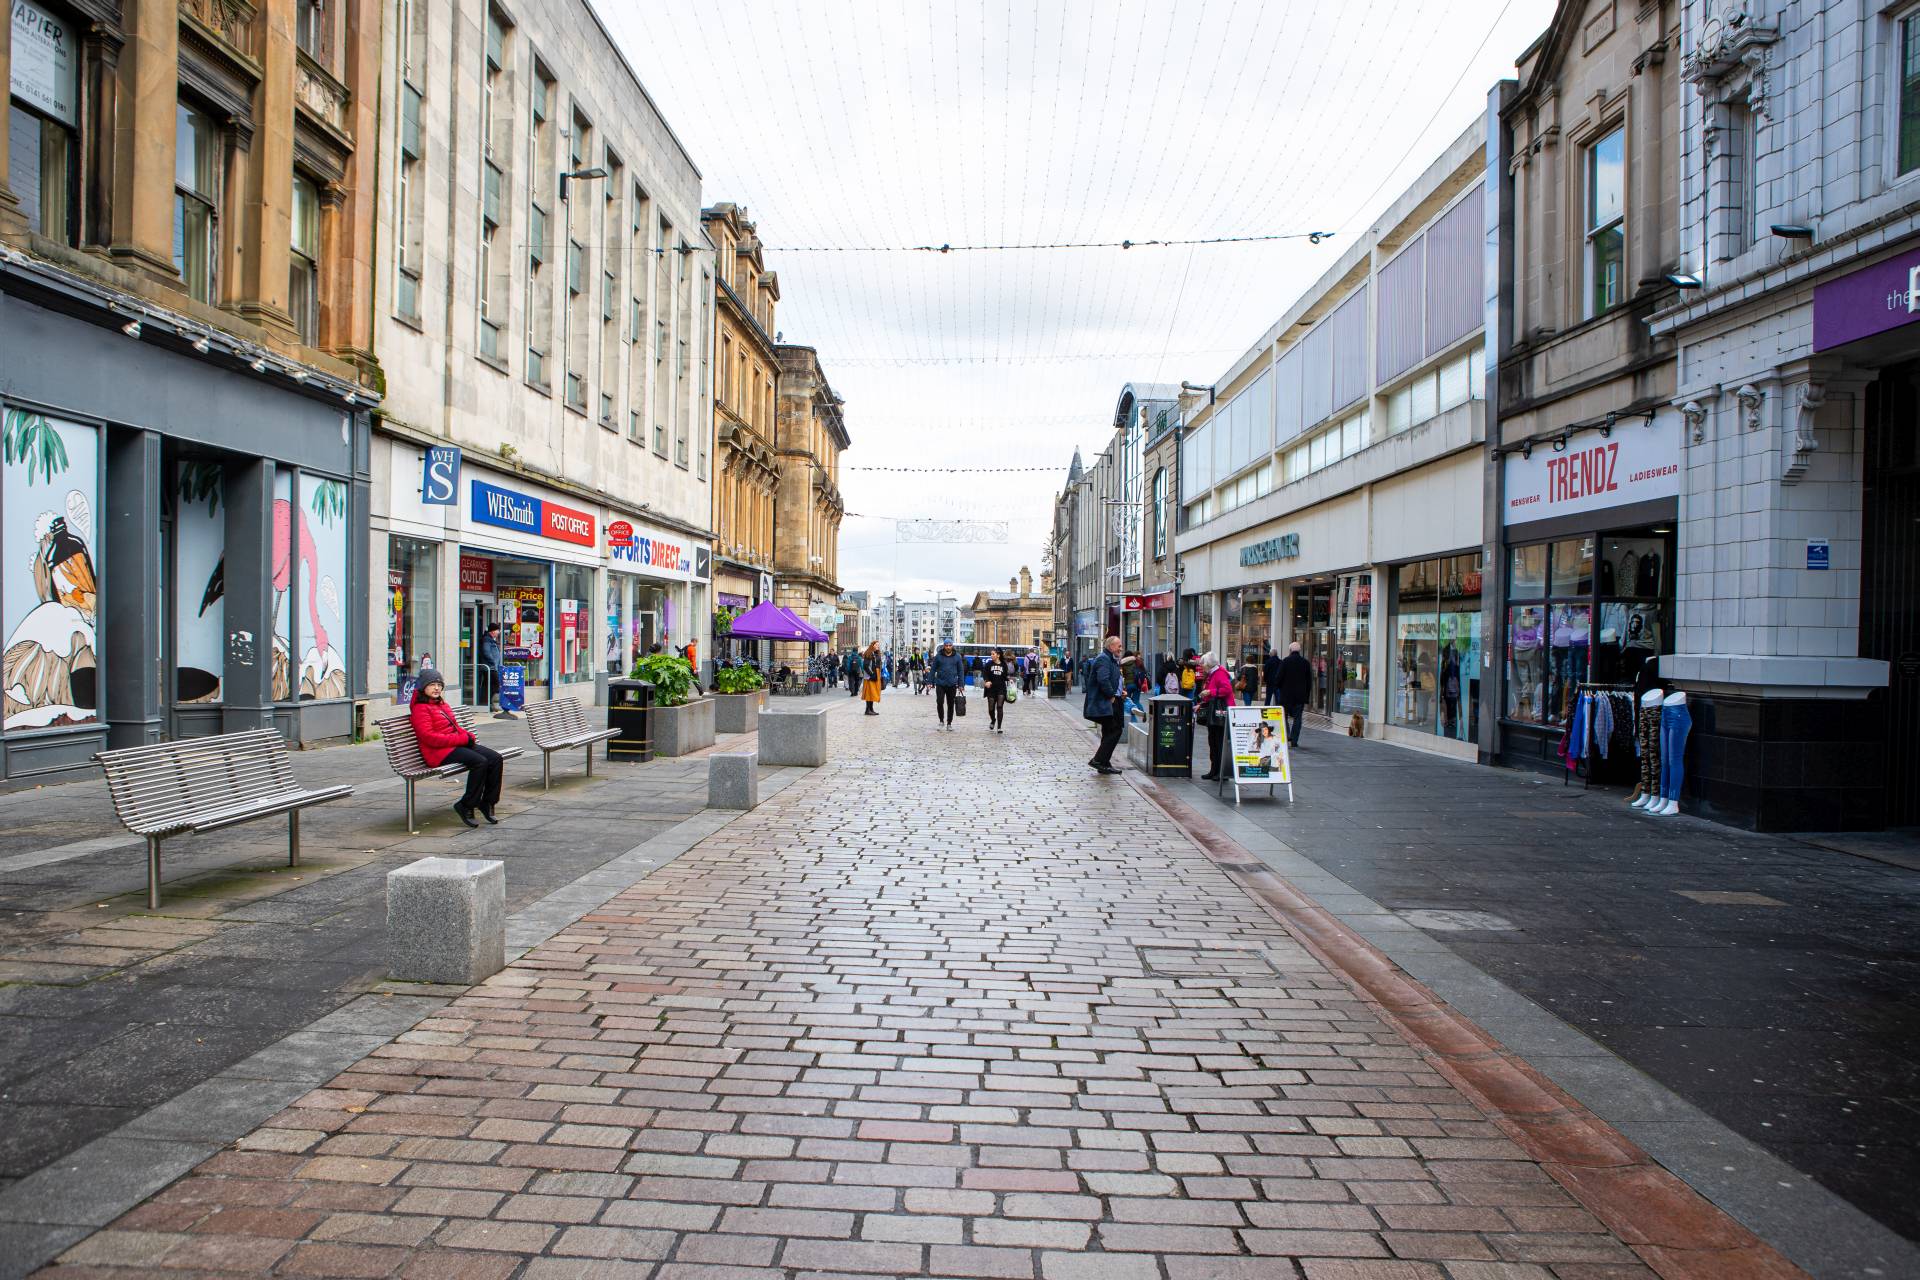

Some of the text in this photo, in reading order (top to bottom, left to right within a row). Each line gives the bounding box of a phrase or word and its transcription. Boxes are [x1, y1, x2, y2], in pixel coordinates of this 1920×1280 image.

[430, 450, 454, 462] WH
[1546, 442, 1619, 504] TRENDZ
[1629, 465, 1678, 482] LADIESWEAR
[427, 461, 454, 501] S
[486, 490, 534, 526] WHSmith
[1510, 494, 1541, 508] MENSWEAR
[551, 512, 590, 537] POST OFFICE
[461, 558, 488, 570] CLEARANCE
[389, 574, 403, 586] Now
[461, 569, 487, 585] OUTLET
[498, 590, 543, 600] Half Price
[509, 671, 520, 680] 25
